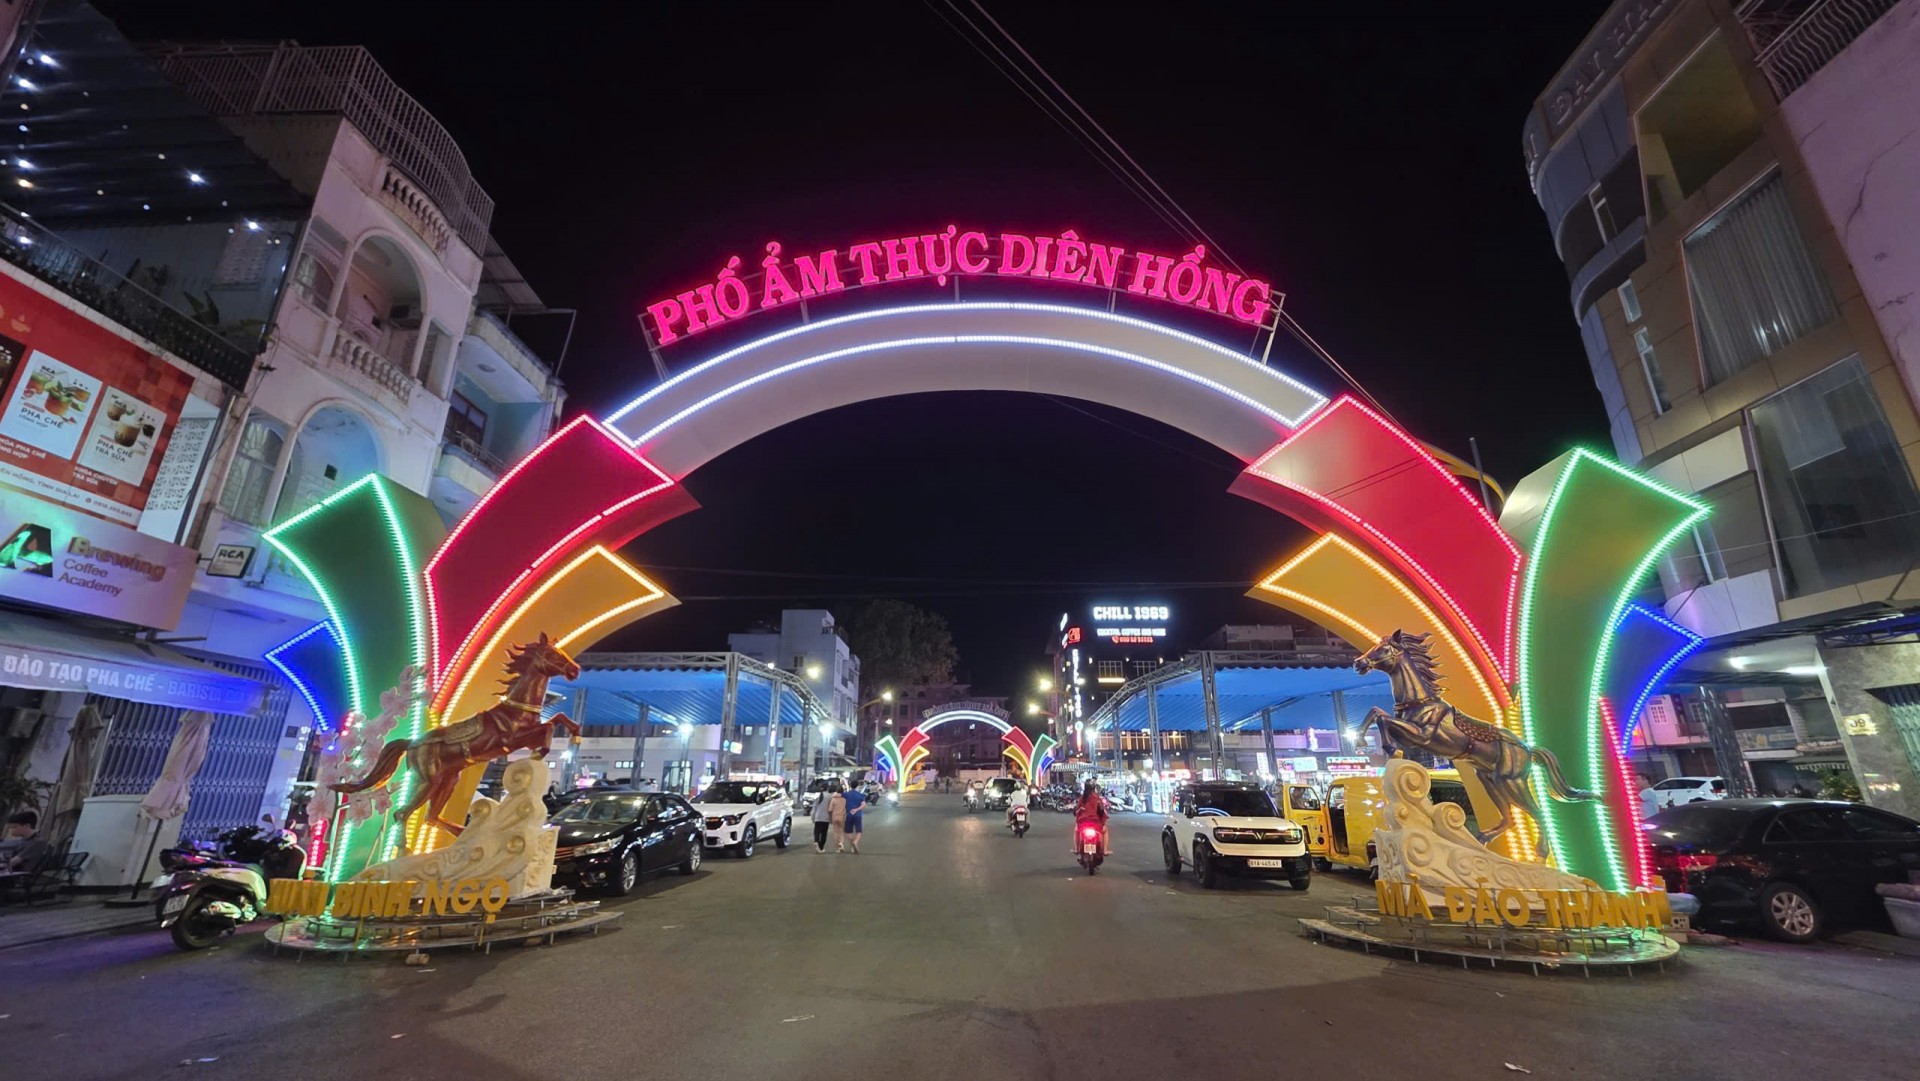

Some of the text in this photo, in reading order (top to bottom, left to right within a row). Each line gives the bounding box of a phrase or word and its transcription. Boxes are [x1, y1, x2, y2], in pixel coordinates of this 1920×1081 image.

[647, 224, 1271, 345] PHỐ ẨM THỰC DIÊN HỒNG
[21, 407, 41, 420] PHA
[97, 439, 115, 451] PHA
[63, 558, 109, 578] Coffee
[67, 536, 167, 582] Brewing
[58, 572, 123, 597] Academy
[1093, 606, 1169, 620] CHILL 1969
[3, 654, 43, 676] ĐÀO
[49, 662, 83, 684] TẠO
[87, 668, 119, 687] PHA
[124, 672, 158, 692] CHẾ
[422, 876, 510, 924] NGỌ
